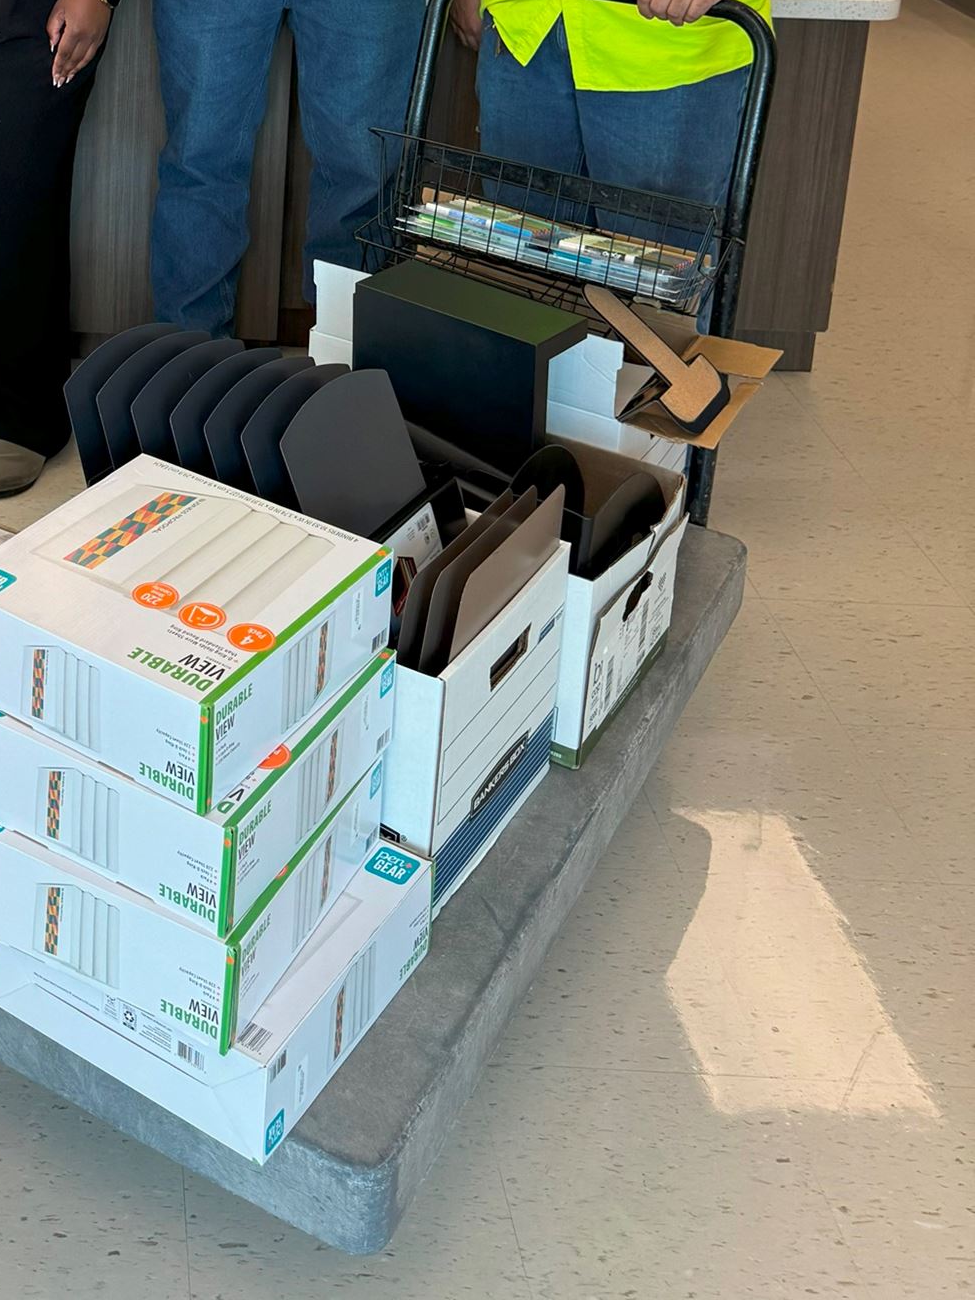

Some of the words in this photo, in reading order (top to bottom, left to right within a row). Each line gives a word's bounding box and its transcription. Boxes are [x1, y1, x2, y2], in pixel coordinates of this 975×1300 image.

[140, 592, 163, 605] 220
[239, 635, 254, 645] 4
[248, 628, 267, 640] Pack
[127, 647, 215, 692] DURABLE
[178, 653, 226, 681] VIEW
[216, 683, 253, 726] DURABLE
[215, 714, 235, 740] VIEW
[509, 741, 527, 768] BOX
[139, 762, 194, 801] DURABLE
[165, 760, 195, 786] VIEW
[238, 800, 272, 846] DURABLE
[238, 832, 256, 860] VIEW
[373, 860, 407, 880] GEAR
[159, 882, 216, 924] DURABLE
[187, 882, 217, 909] VIEW
[399, 938, 428, 981] DURABLE
[160, 998, 218, 1040] DURABLE
[188, 999, 219, 1025] VIEW
